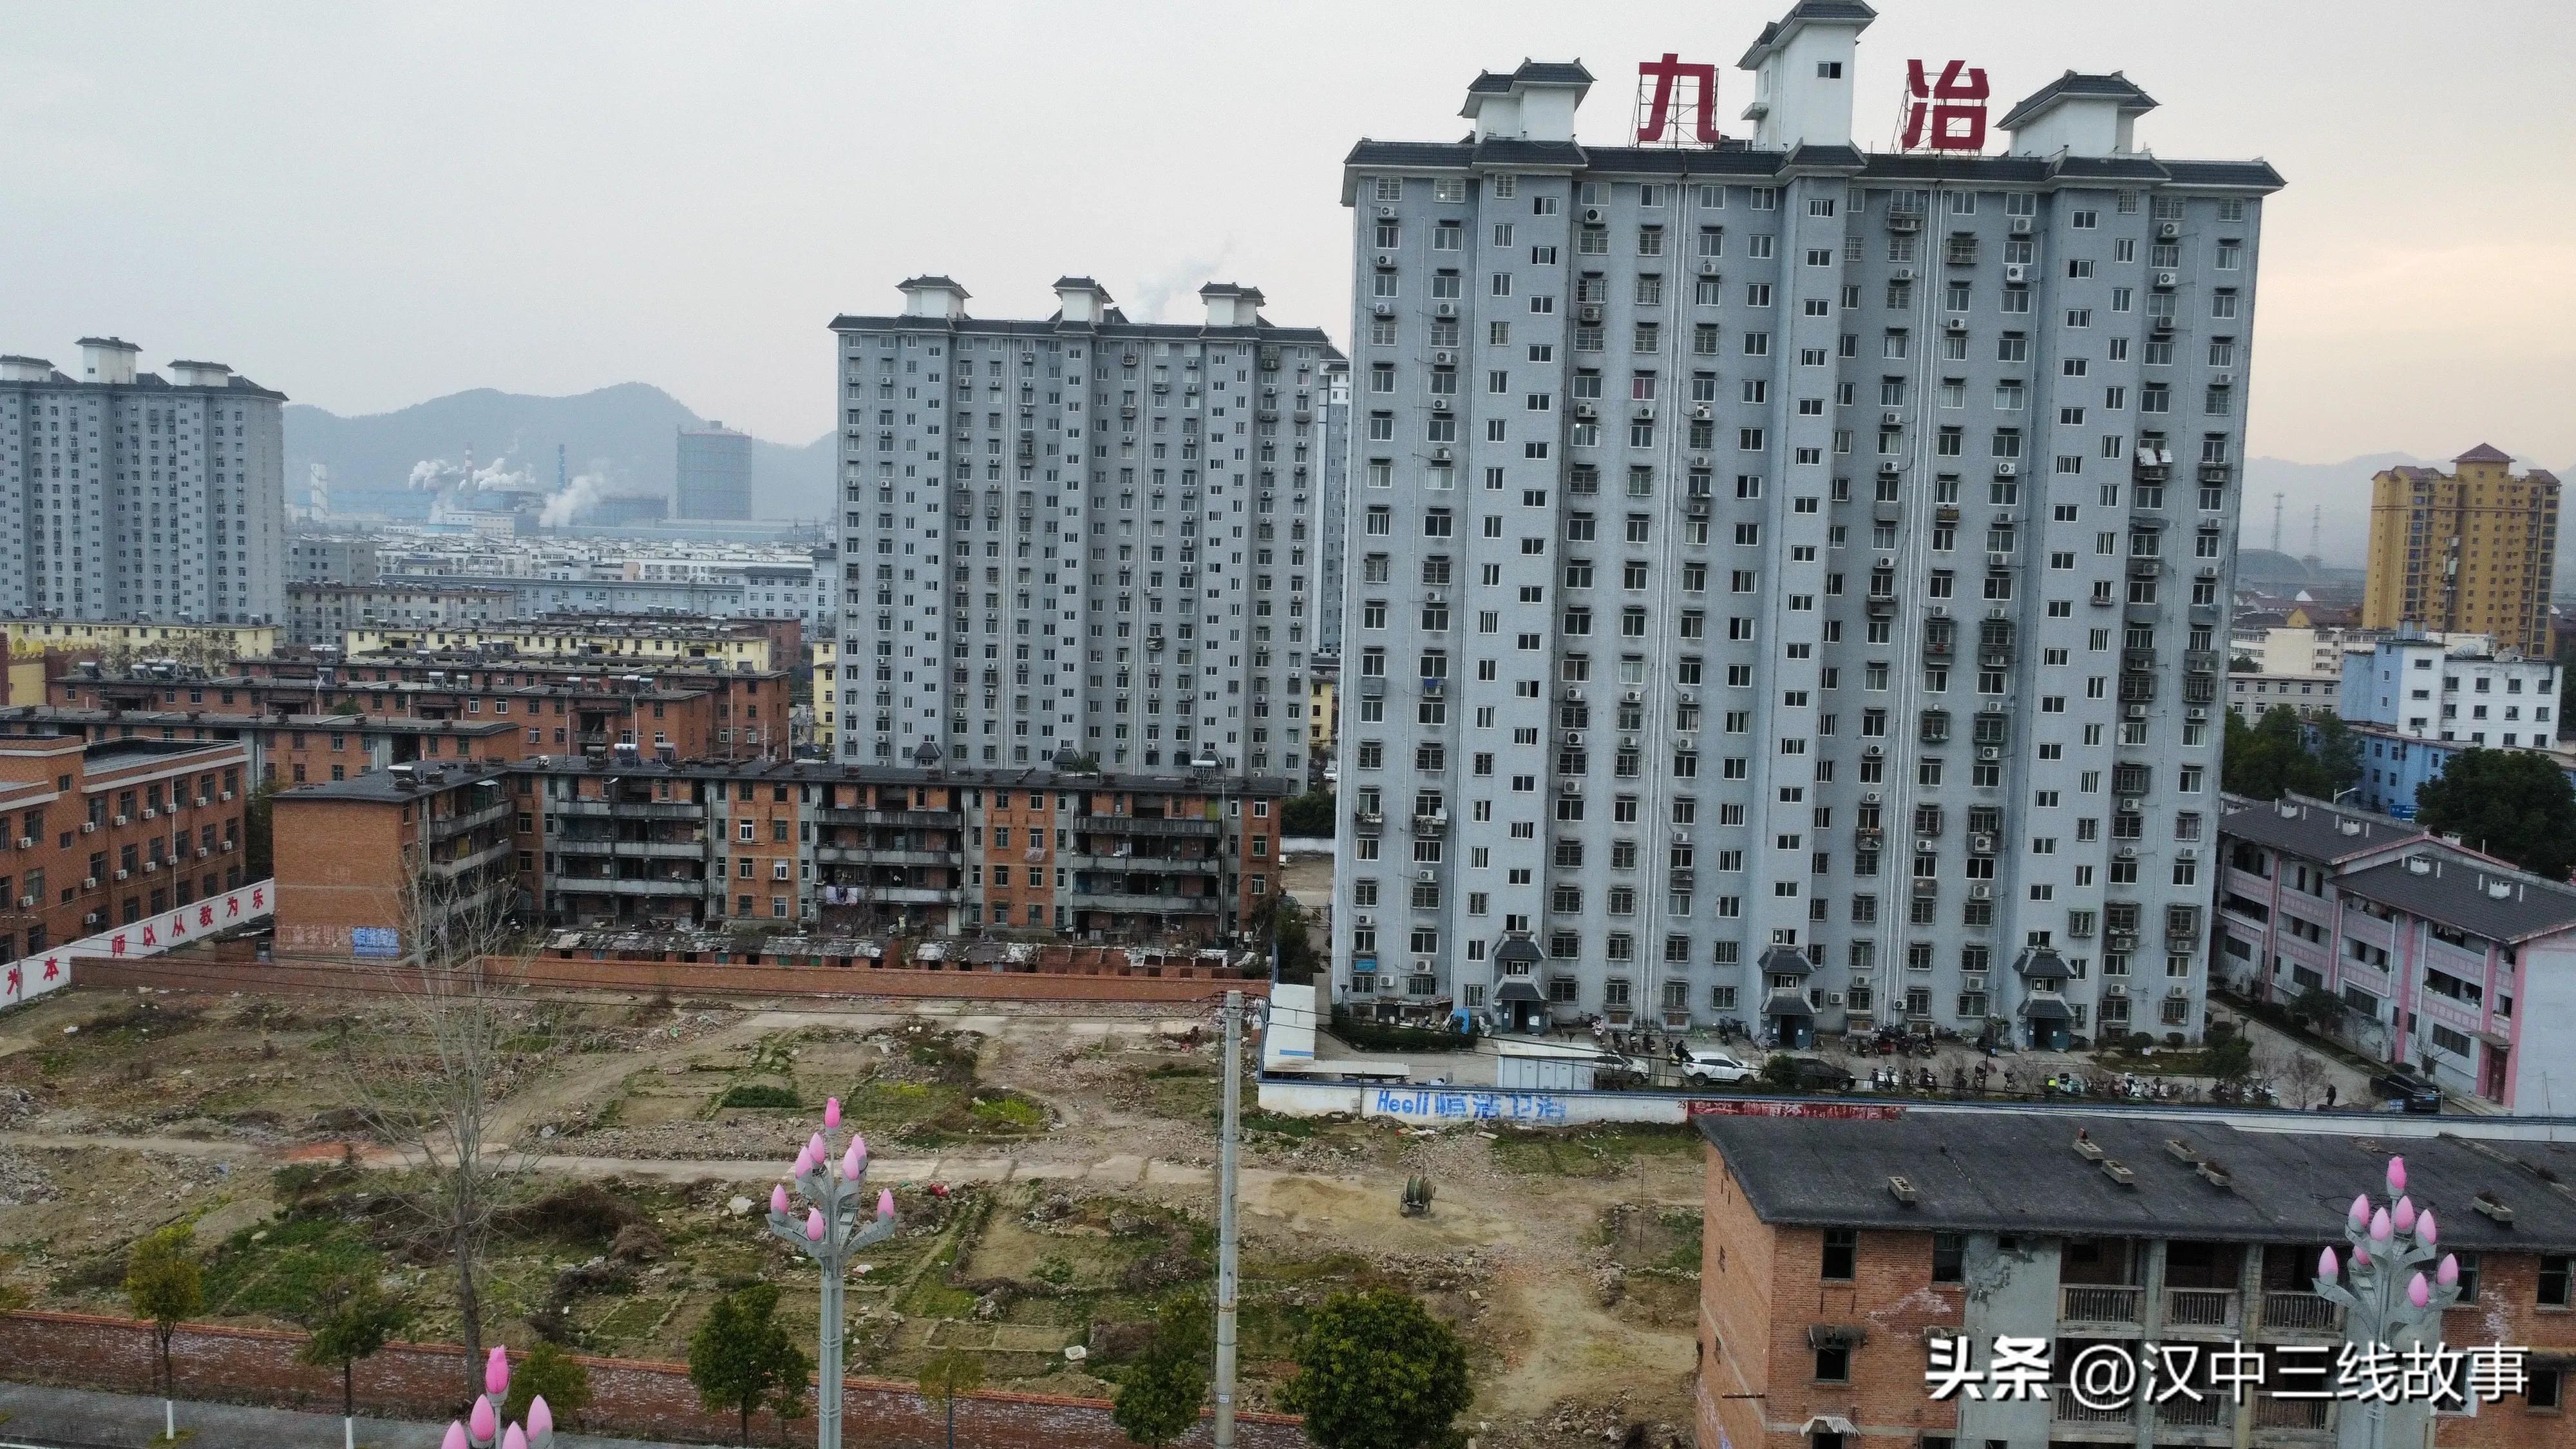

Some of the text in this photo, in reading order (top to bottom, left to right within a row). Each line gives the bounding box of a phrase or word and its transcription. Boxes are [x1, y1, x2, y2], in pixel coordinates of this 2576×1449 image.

[111, 887, 264, 958] 师以从教为乐
